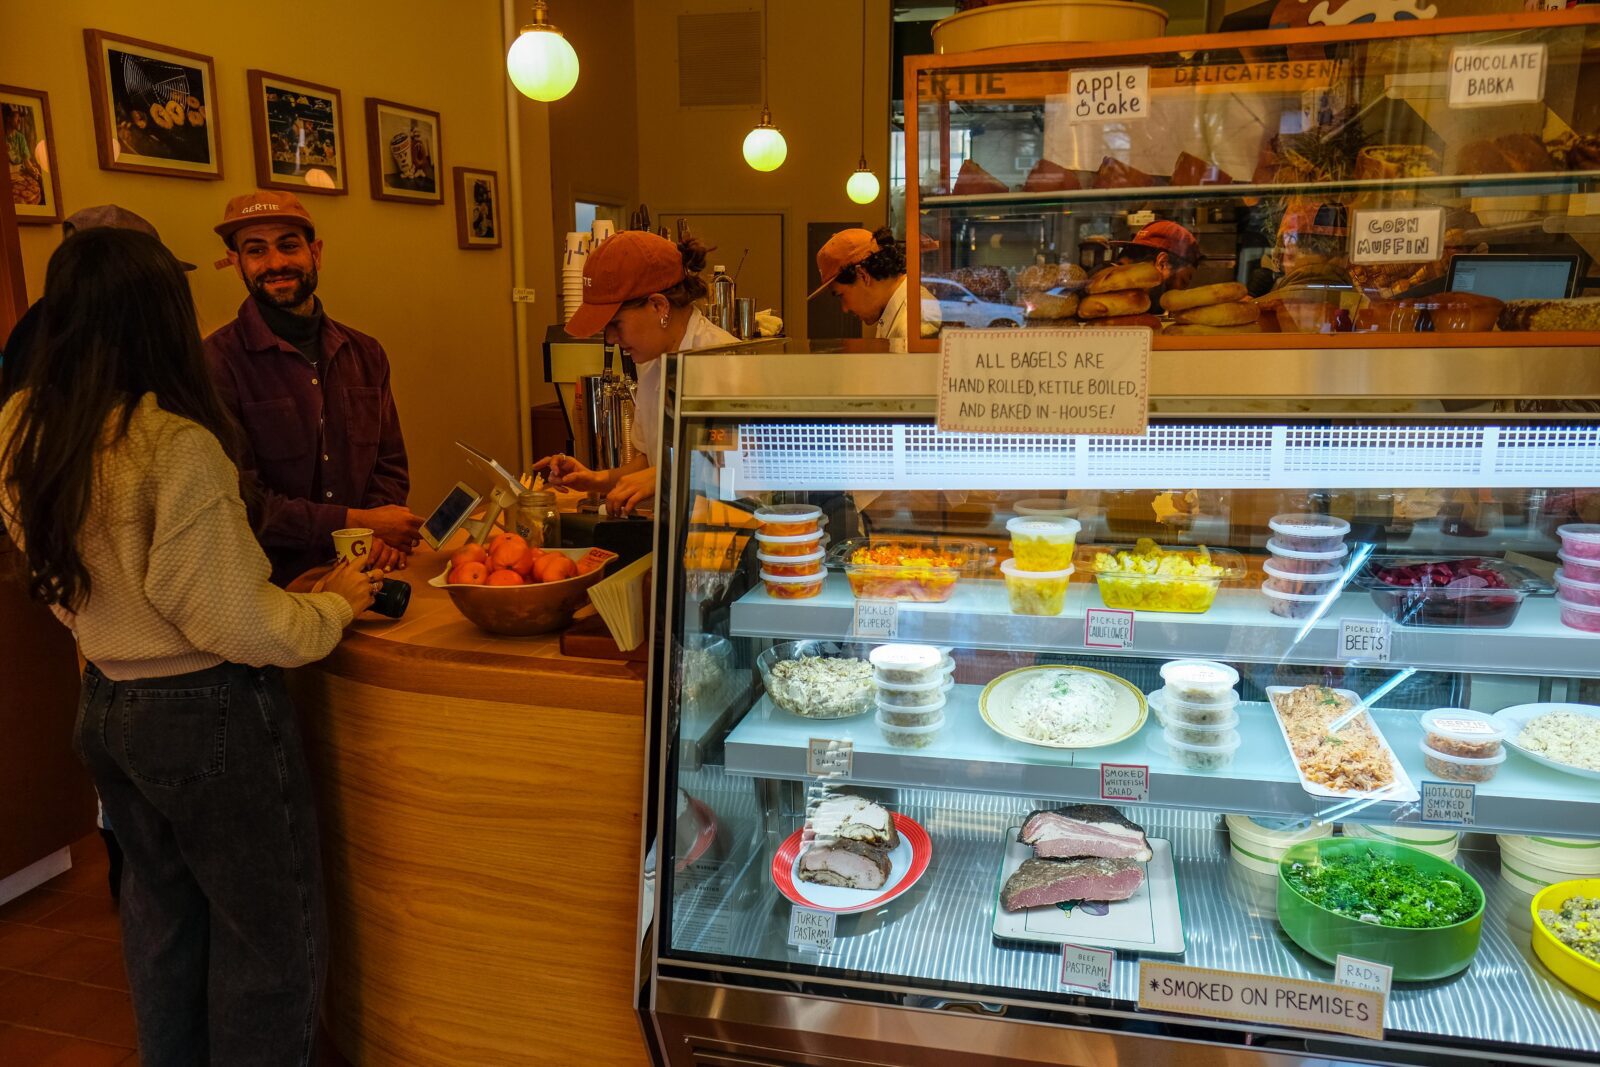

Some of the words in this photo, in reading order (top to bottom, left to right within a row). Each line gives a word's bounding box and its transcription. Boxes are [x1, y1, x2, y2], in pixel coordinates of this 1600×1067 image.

[1454, 52, 1539, 73] CHOCOLATE
[1174, 62, 1331, 84] DELICATESSEN
[1076, 72, 1136, 102] apple
[1467, 77, 1514, 96] BABKA
[1096, 93, 1140, 115] cake
[241, 203, 280, 214] GERTIE
[1368, 217, 1419, 234] CORN
[1357, 236, 1429, 255] MUFFIN
[975, 353, 1005, 368] ALL
[1011, 351, 1067, 369] BAGELS
[1074, 352, 1105, 369] ARE
[949, 377, 984, 393] HAND
[1039, 379, 1083, 395] KETTLE
[1088, 379, 1139, 398] BOILED,
[959, 402, 986, 417] AND
[991, 403, 1031, 420] BAKED
[351, 540, 367, 557] G
[858, 605, 895, 616] PICKLED
[858, 618, 891, 629] PEPPERS
[1090, 615, 1130, 626] PICKLED
[1345, 624, 1382, 634] PICKLED
[1089, 626, 1129, 640] CAULIFLOWER
[1345, 634, 1385, 651] BEETS
[1104, 769, 1145, 779] SMOKED
[1104, 779, 1145, 787] WHITEFISH
[1107, 787, 1133, 796] SALAD
[1427, 799, 1465, 810] SMOKED
[1426, 808, 1463, 819] SALMON
[796, 911, 831, 928] TURKEY
[793, 925, 830, 941] PASTRAMI
[1079, 953, 1096, 962] BEEF
[1065, 960, 1107, 978] PASTRAMI
[1347, 964, 1381, 983] R&D's
[1241, 987, 1267, 1006] ON
[1275, 988, 1369, 1022] PREMISES
